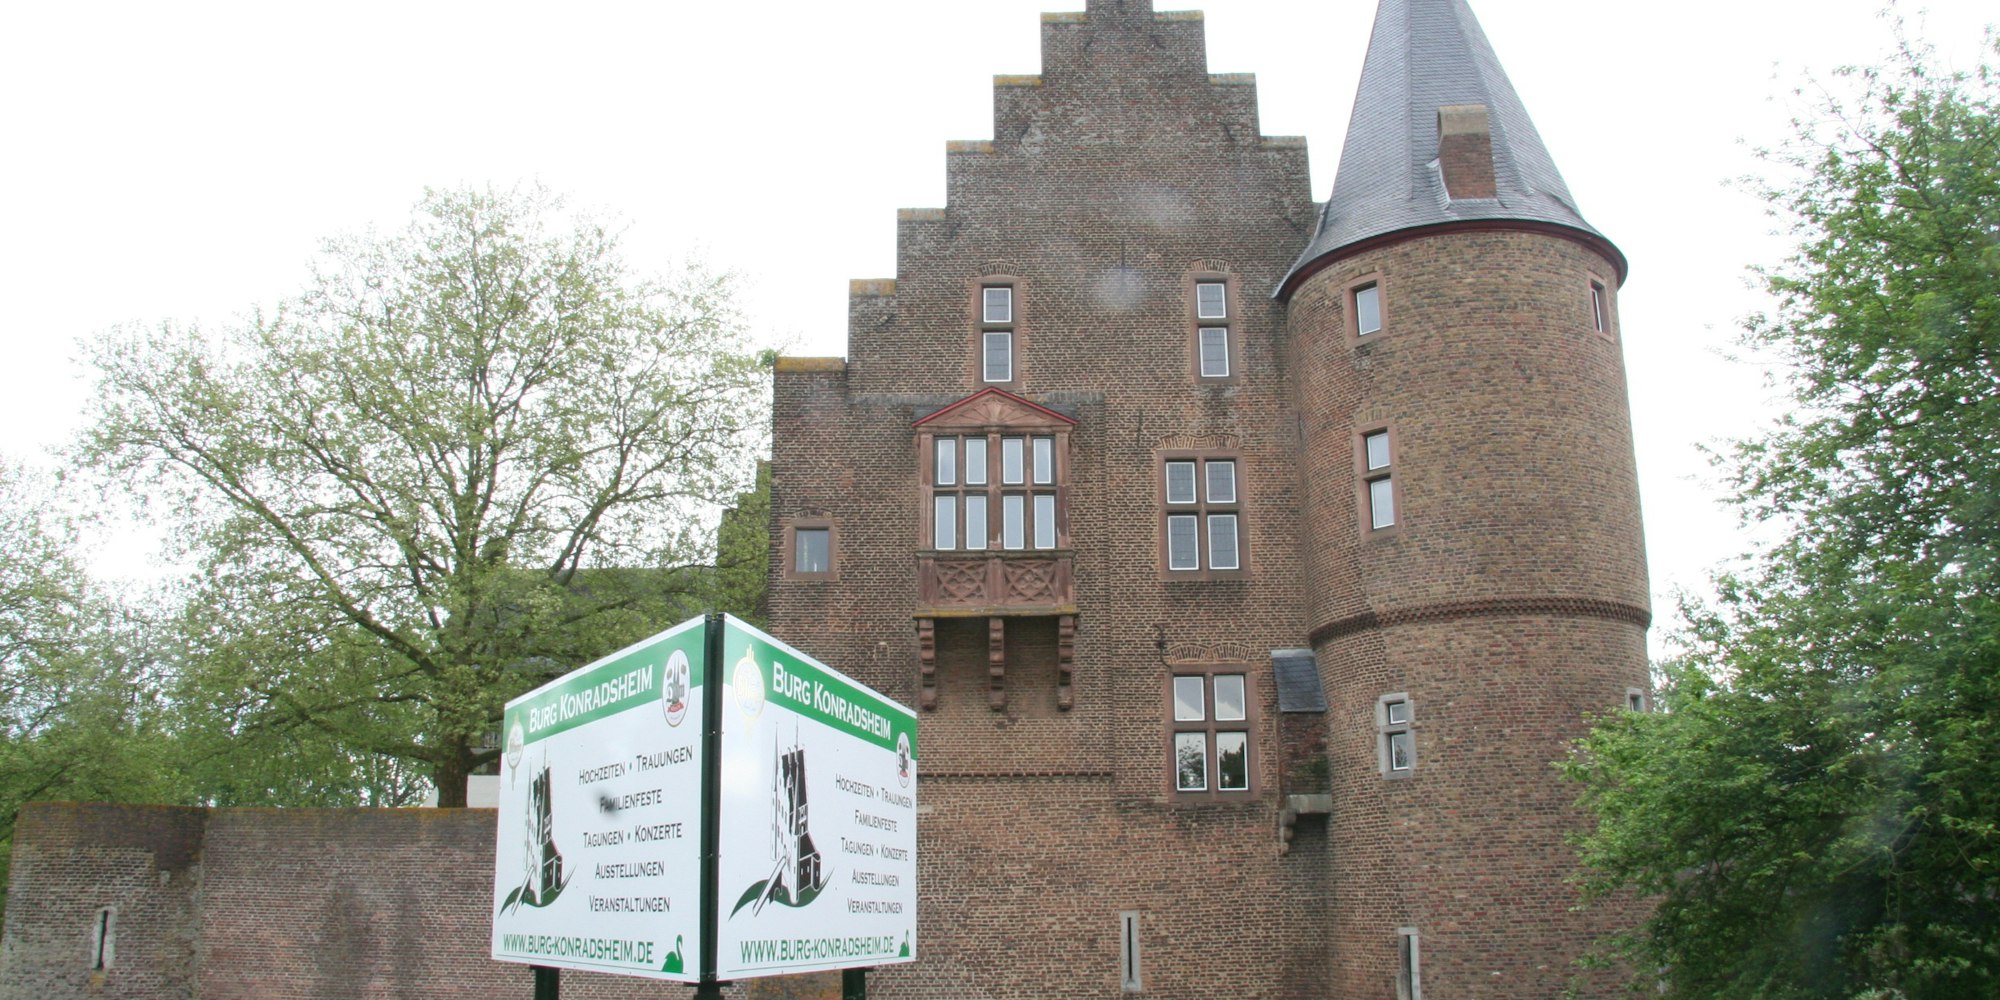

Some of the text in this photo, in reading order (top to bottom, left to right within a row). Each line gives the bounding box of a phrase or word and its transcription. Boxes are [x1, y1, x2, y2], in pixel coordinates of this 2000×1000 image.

[529, 706, 557, 734] BURG
[560, 664, 652, 724] KONRADSHEIM
[773, 661, 811, 705] BURG
[814, 683, 891, 740] KONRADSHEIM
[578, 745, 693, 786] HOCHZEITEN TRAUUNGEN
[835, 773, 913, 809] HOCHZEITEN TRAUUNGEN
[854, 809, 898, 833] FAMILIENFESTE
[583, 822, 683, 848] TAGUNGEN KONZERTE
[840, 836, 908, 862] TAGUNGEN KONZERTE
[595, 861, 664, 879] AUSSTELLUNGEN
[852, 869, 900, 887] AUSSTELLUNGEN
[589, 895, 671, 913] VERANSTALTUNGEN
[847, 897, 903, 914] VERANSTALTUNGEN
[503, 933, 654, 963] WWW.BURG-KONRADSHEIM.DE
[740, 935, 894, 963] WWW.BURG-KONRADSHEIM.DE
